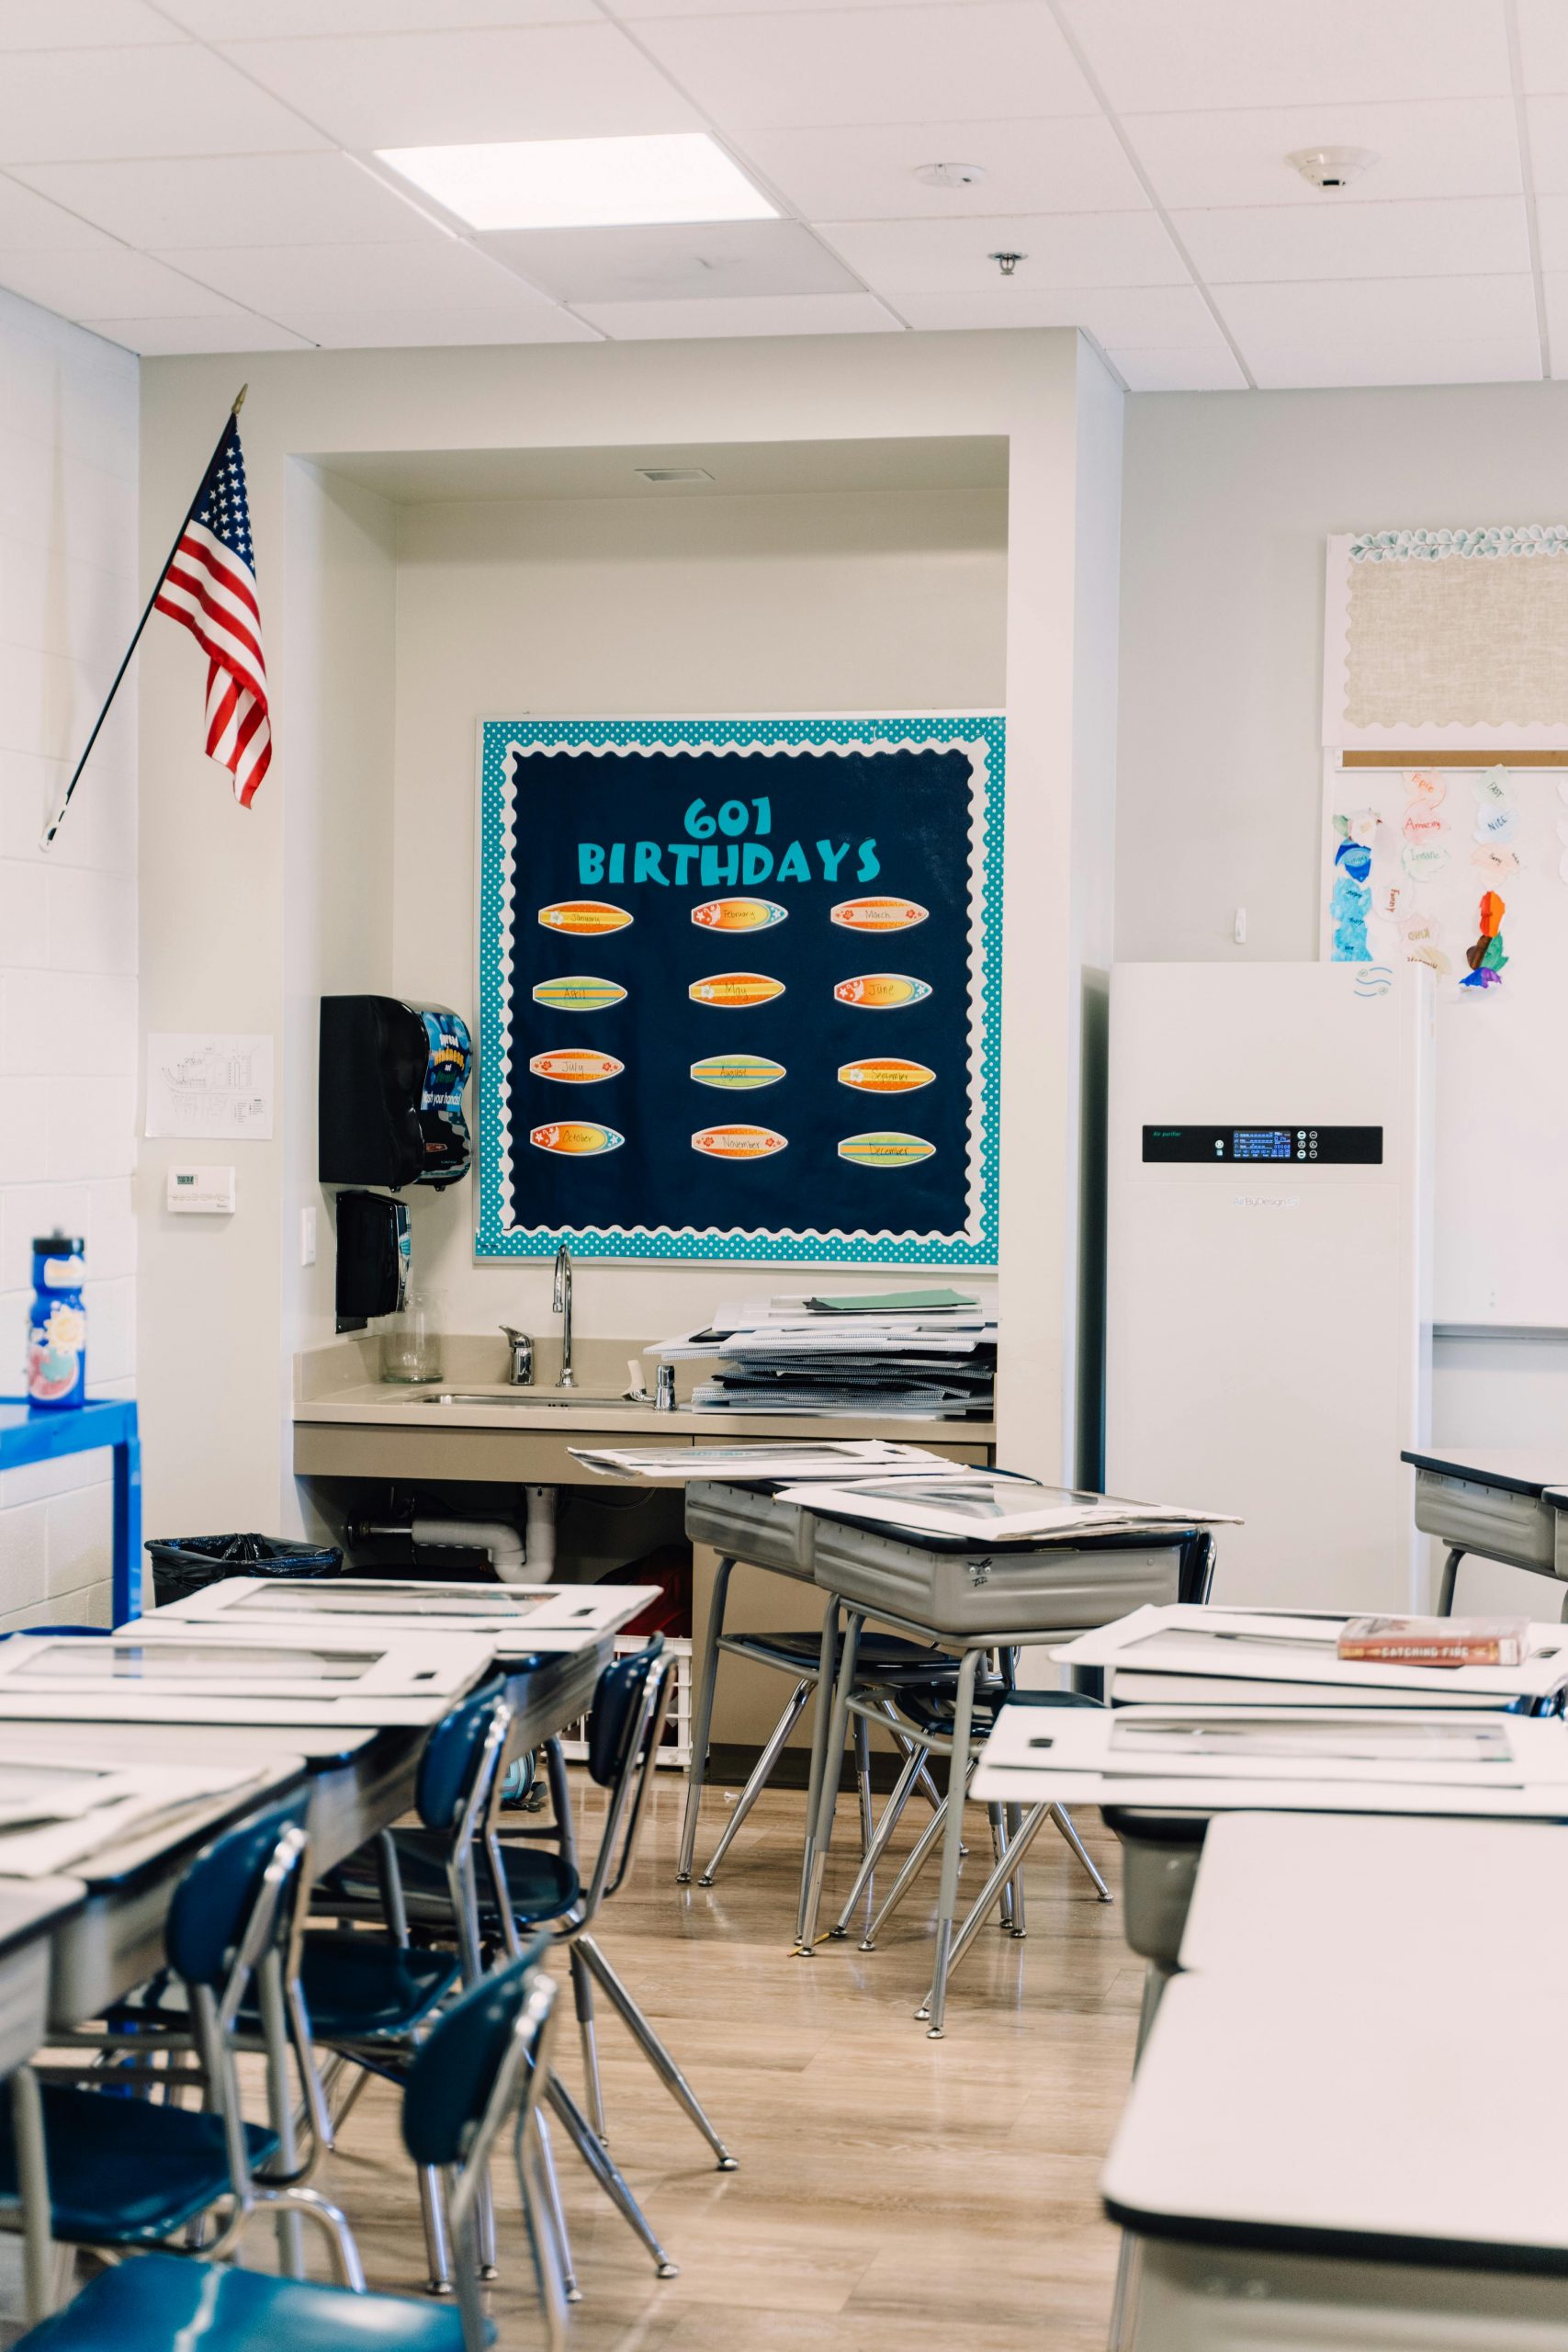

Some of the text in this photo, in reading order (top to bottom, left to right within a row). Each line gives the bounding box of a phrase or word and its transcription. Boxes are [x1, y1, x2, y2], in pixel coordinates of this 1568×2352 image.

[1487, 782, 1505, 797] FAST
[684, 797, 772, 839] 601
[1487, 815, 1507, 831] NICE
[578, 838, 881, 887] BIRTHDAYS
[571, 913, 601, 924] January
[724, 909, 755, 920] February
[864, 910, 891, 919] March
[563, 989, 586, 1000] April
[725, 982, 749, 1001] May
[868, 984, 895, 996] June
[561, 1061, 584, 1076] July
[720, 1066, 748, 1080] August
[871, 1069, 908, 1083] September
[562, 1130, 592, 1143] October
[723, 1136, 760, 1148] November
[869, 1143, 908, 1156] December
[1381, 1646, 1438, 1658] CATCHING
